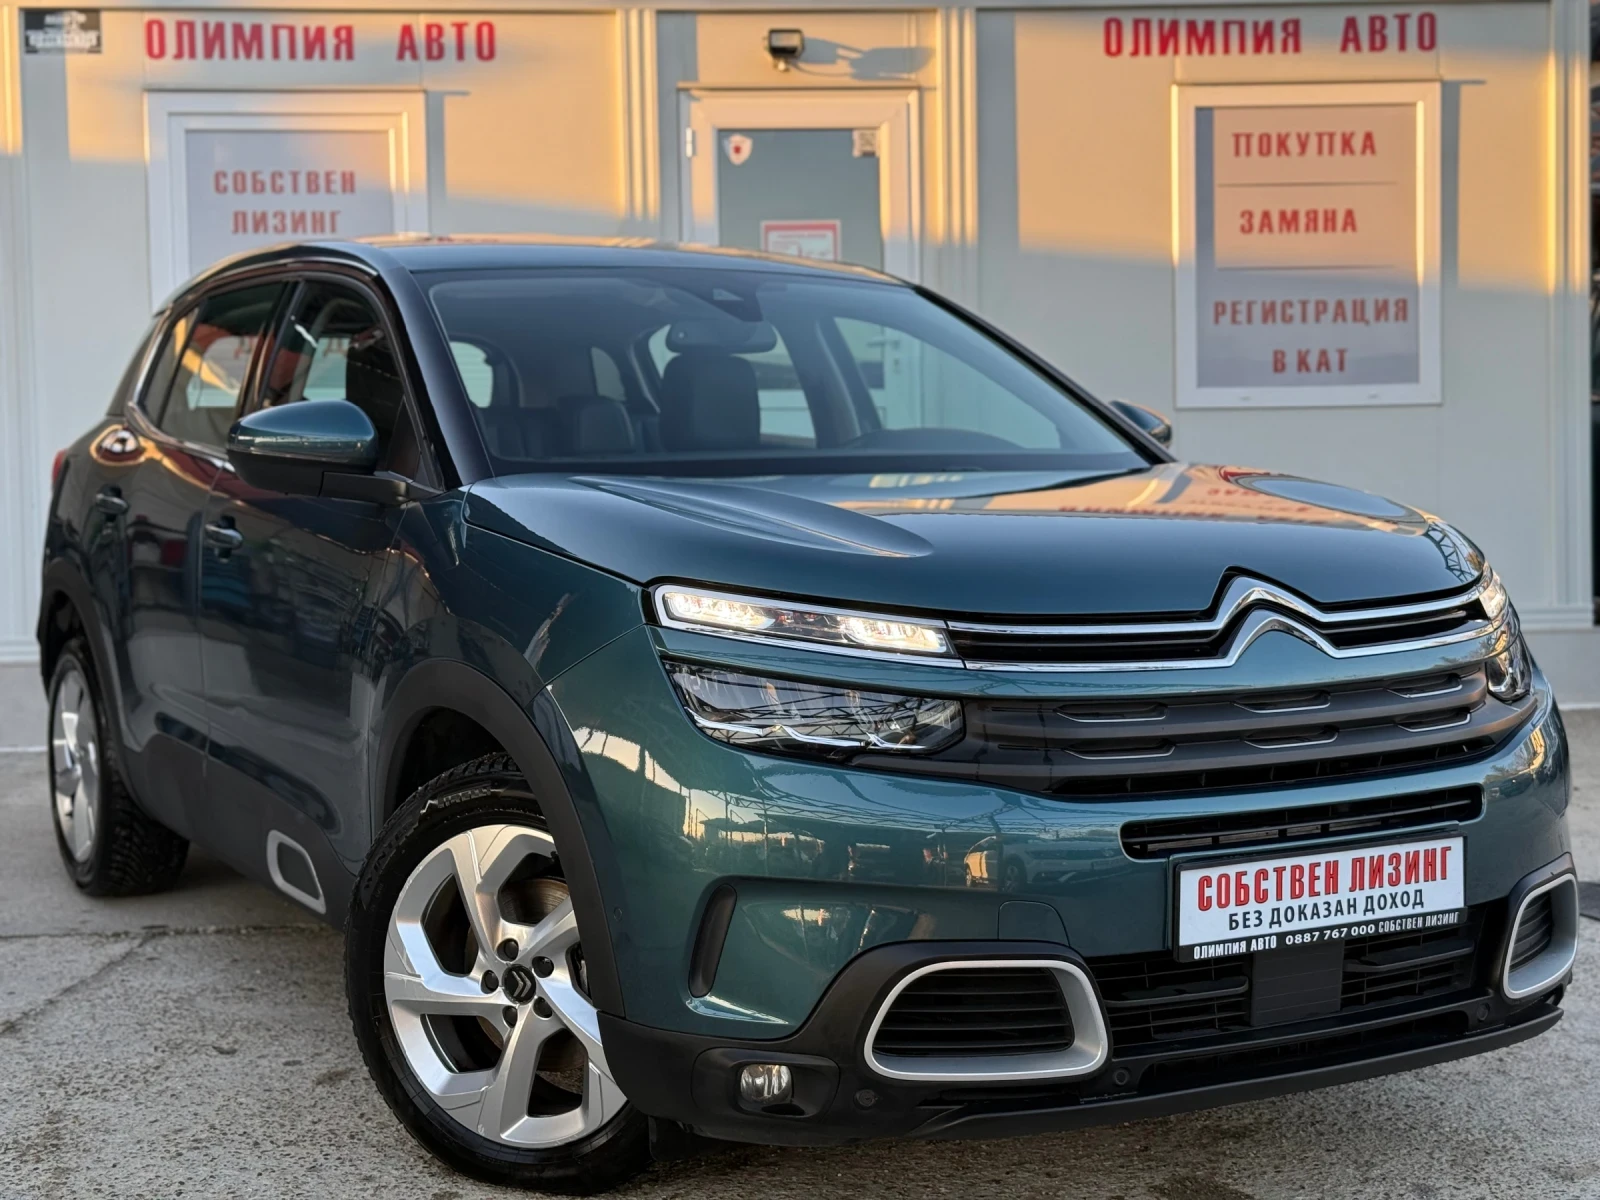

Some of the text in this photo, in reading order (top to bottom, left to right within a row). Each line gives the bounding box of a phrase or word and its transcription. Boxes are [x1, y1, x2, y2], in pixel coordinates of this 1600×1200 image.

[145, 19, 356, 62] ОЛИМПИЯ
[397, 21, 498, 62] АВТО
[1103, 12, 1437, 57] ОЛИМПИЯ АВТО
[1232, 130, 1377, 158] ПОКУПКА
[213, 169, 357, 196] СОБСТВЕН
[231, 210, 342, 236] ЛИЗИНГ
[1239, 208, 1358, 236] ЗАМЯНА
[1213, 298, 1409, 326] РЕГИСТРАЦИЯ
[1272, 348, 1349, 374] В КАТ
[1198, 846, 1451, 911] СОБСТВЕН ЛИЗИНГ
[1229, 888, 1424, 931] БЕЗ ДОКАЗАН ДОХОД
[1194, 911, 1460, 960] ОЛИМПИЯ АВТО 0887 767 000 СОБСТВЕН ЛИЗИНГ
